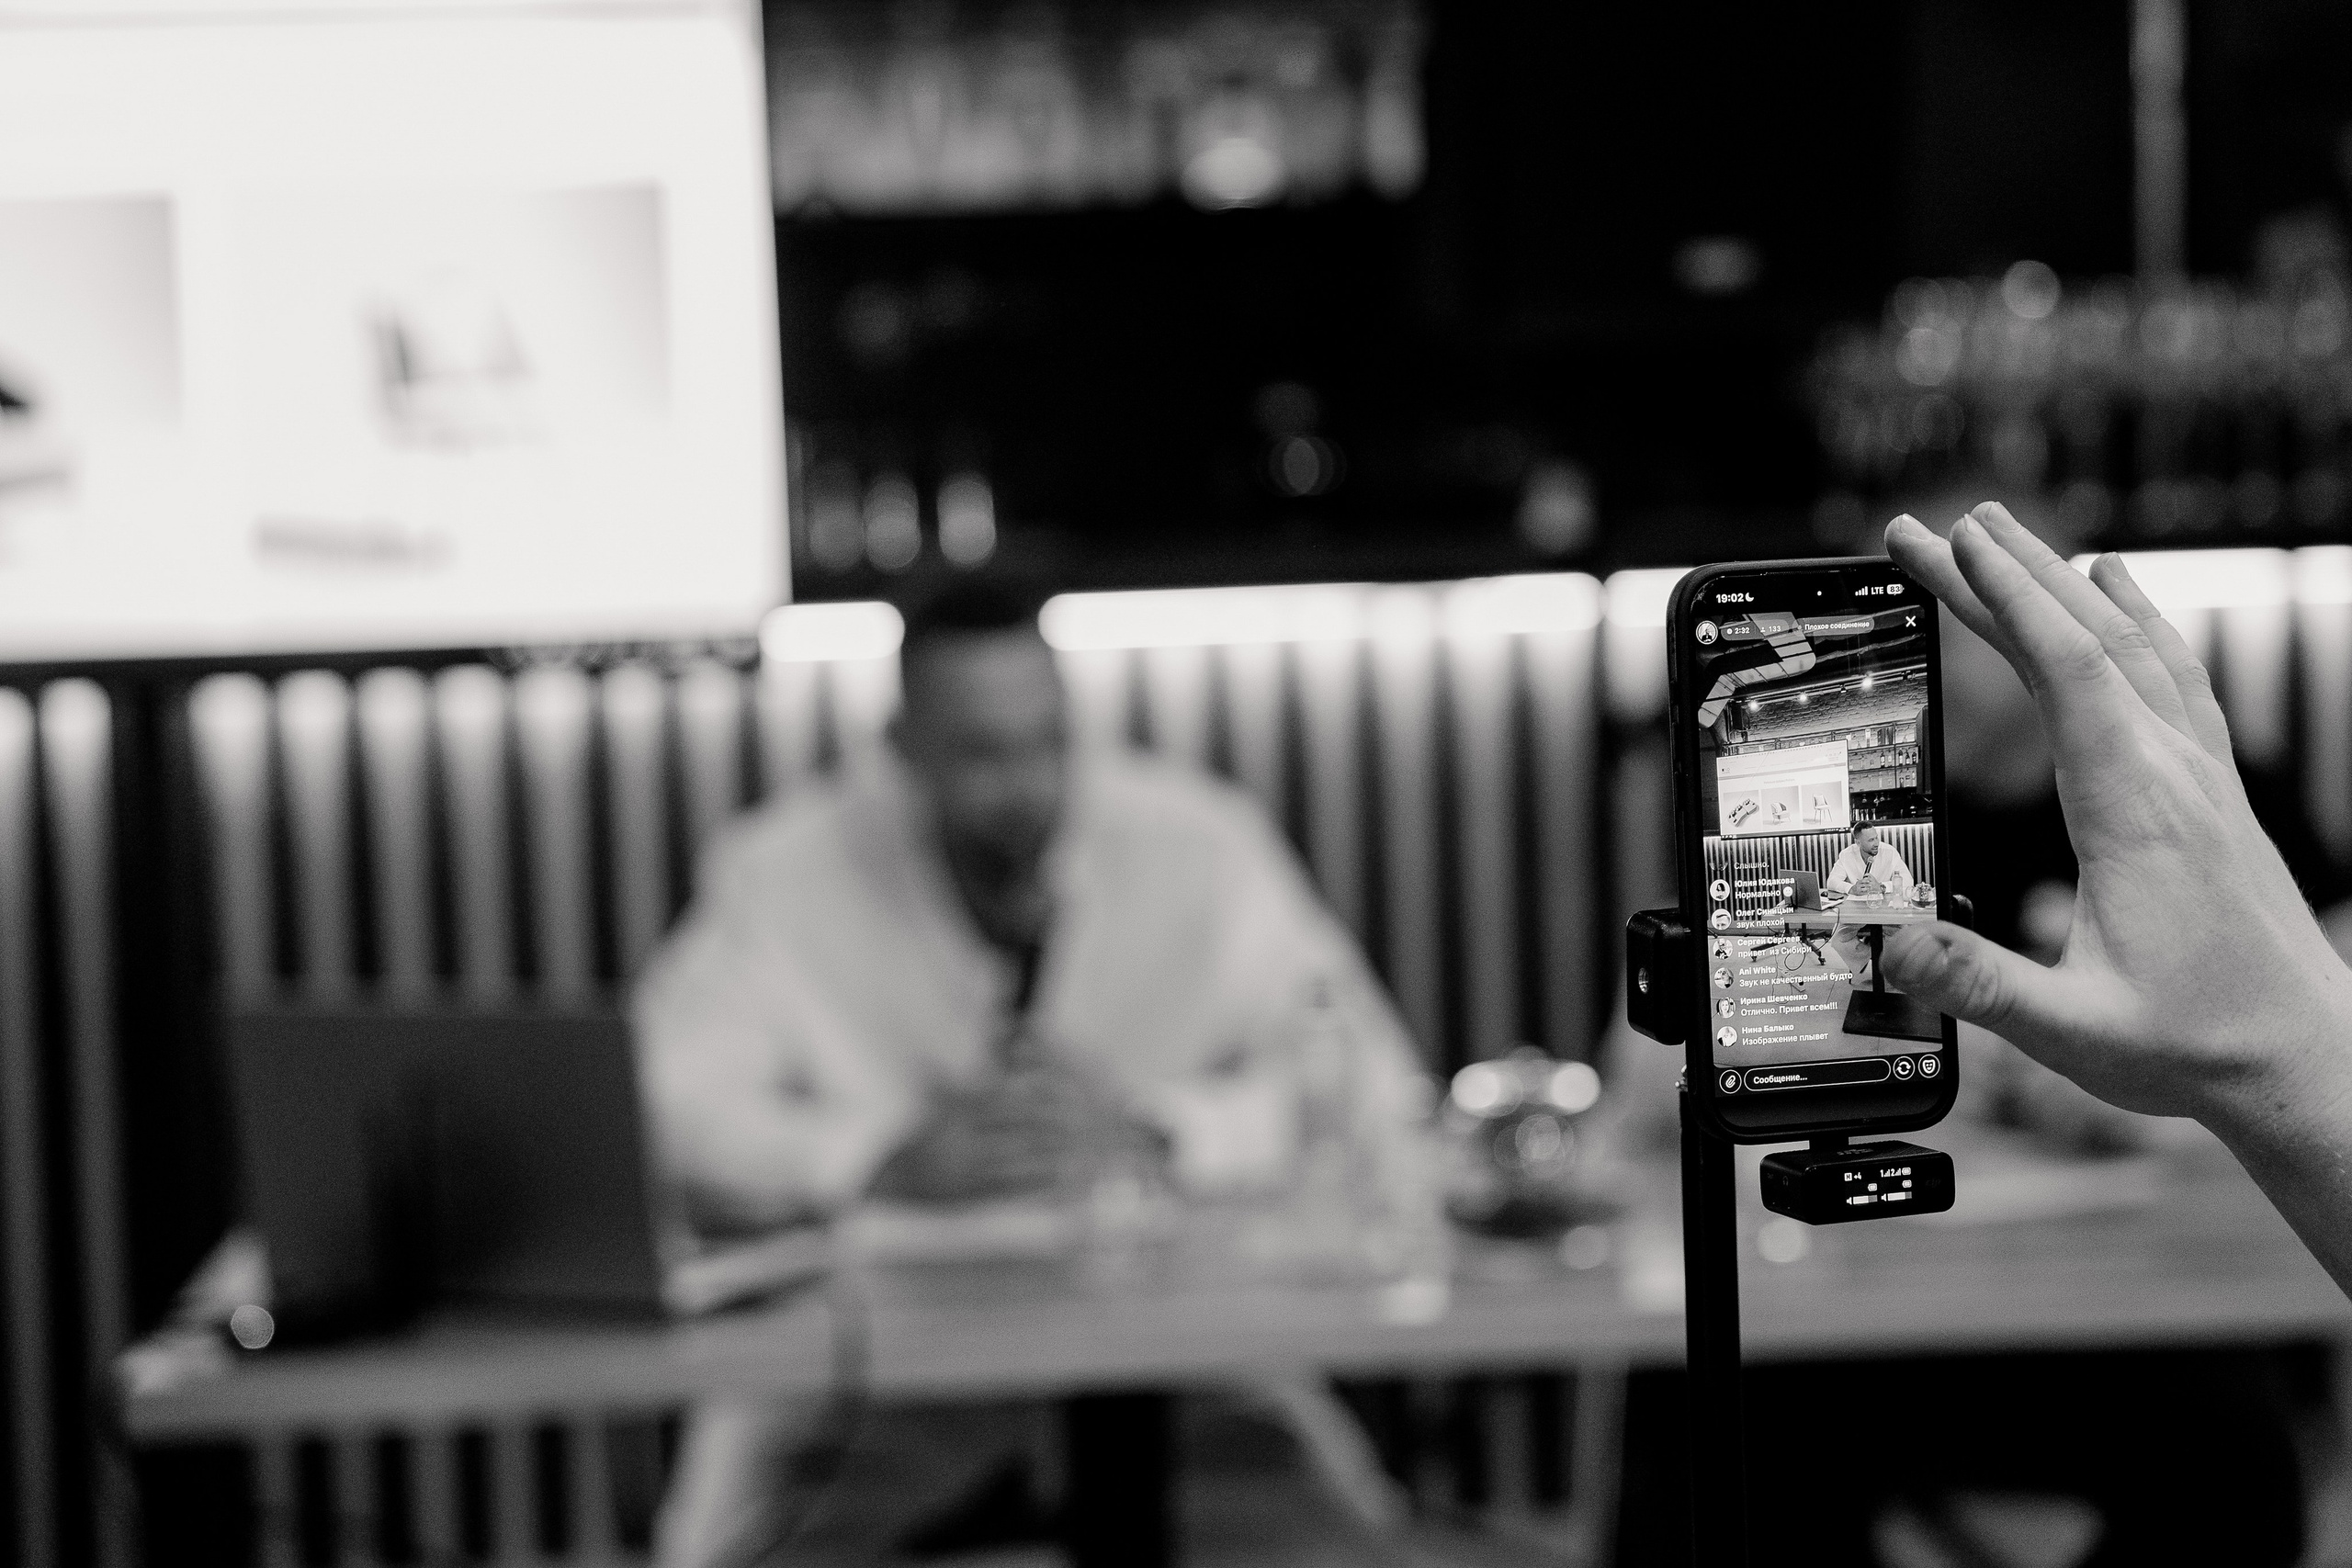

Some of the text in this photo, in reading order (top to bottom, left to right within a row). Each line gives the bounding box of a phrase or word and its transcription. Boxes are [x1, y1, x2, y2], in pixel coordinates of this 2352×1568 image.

[1871, 587, 1884, 595] LTE
[1716, 593, 1744, 604] 19:02
[1735, 877, 1795, 888] Юлия Юдакова
[1735, 890, 1781, 900] Нормально
[1757, 907, 1794, 915] Синицын
[1756, 917, 1785, 927] плохой
[1738, 937, 1765, 946] Сергей
[1738, 950, 1765, 958] привет
[1781, 946, 1812, 955] Сибири
[1772, 974, 1828, 985] качественный
[1830, 973, 1853, 981] будто
[1741, 994, 1808, 1006] Ирина Шевченко
[1741, 1002, 1838, 1016] Отлично. Привет всем!!!
[1764, 1024, 1794, 1032] Балыко
[1742, 1035, 1798, 1045] Изображение
[1753, 1074, 1808, 1084] Сообщение...
